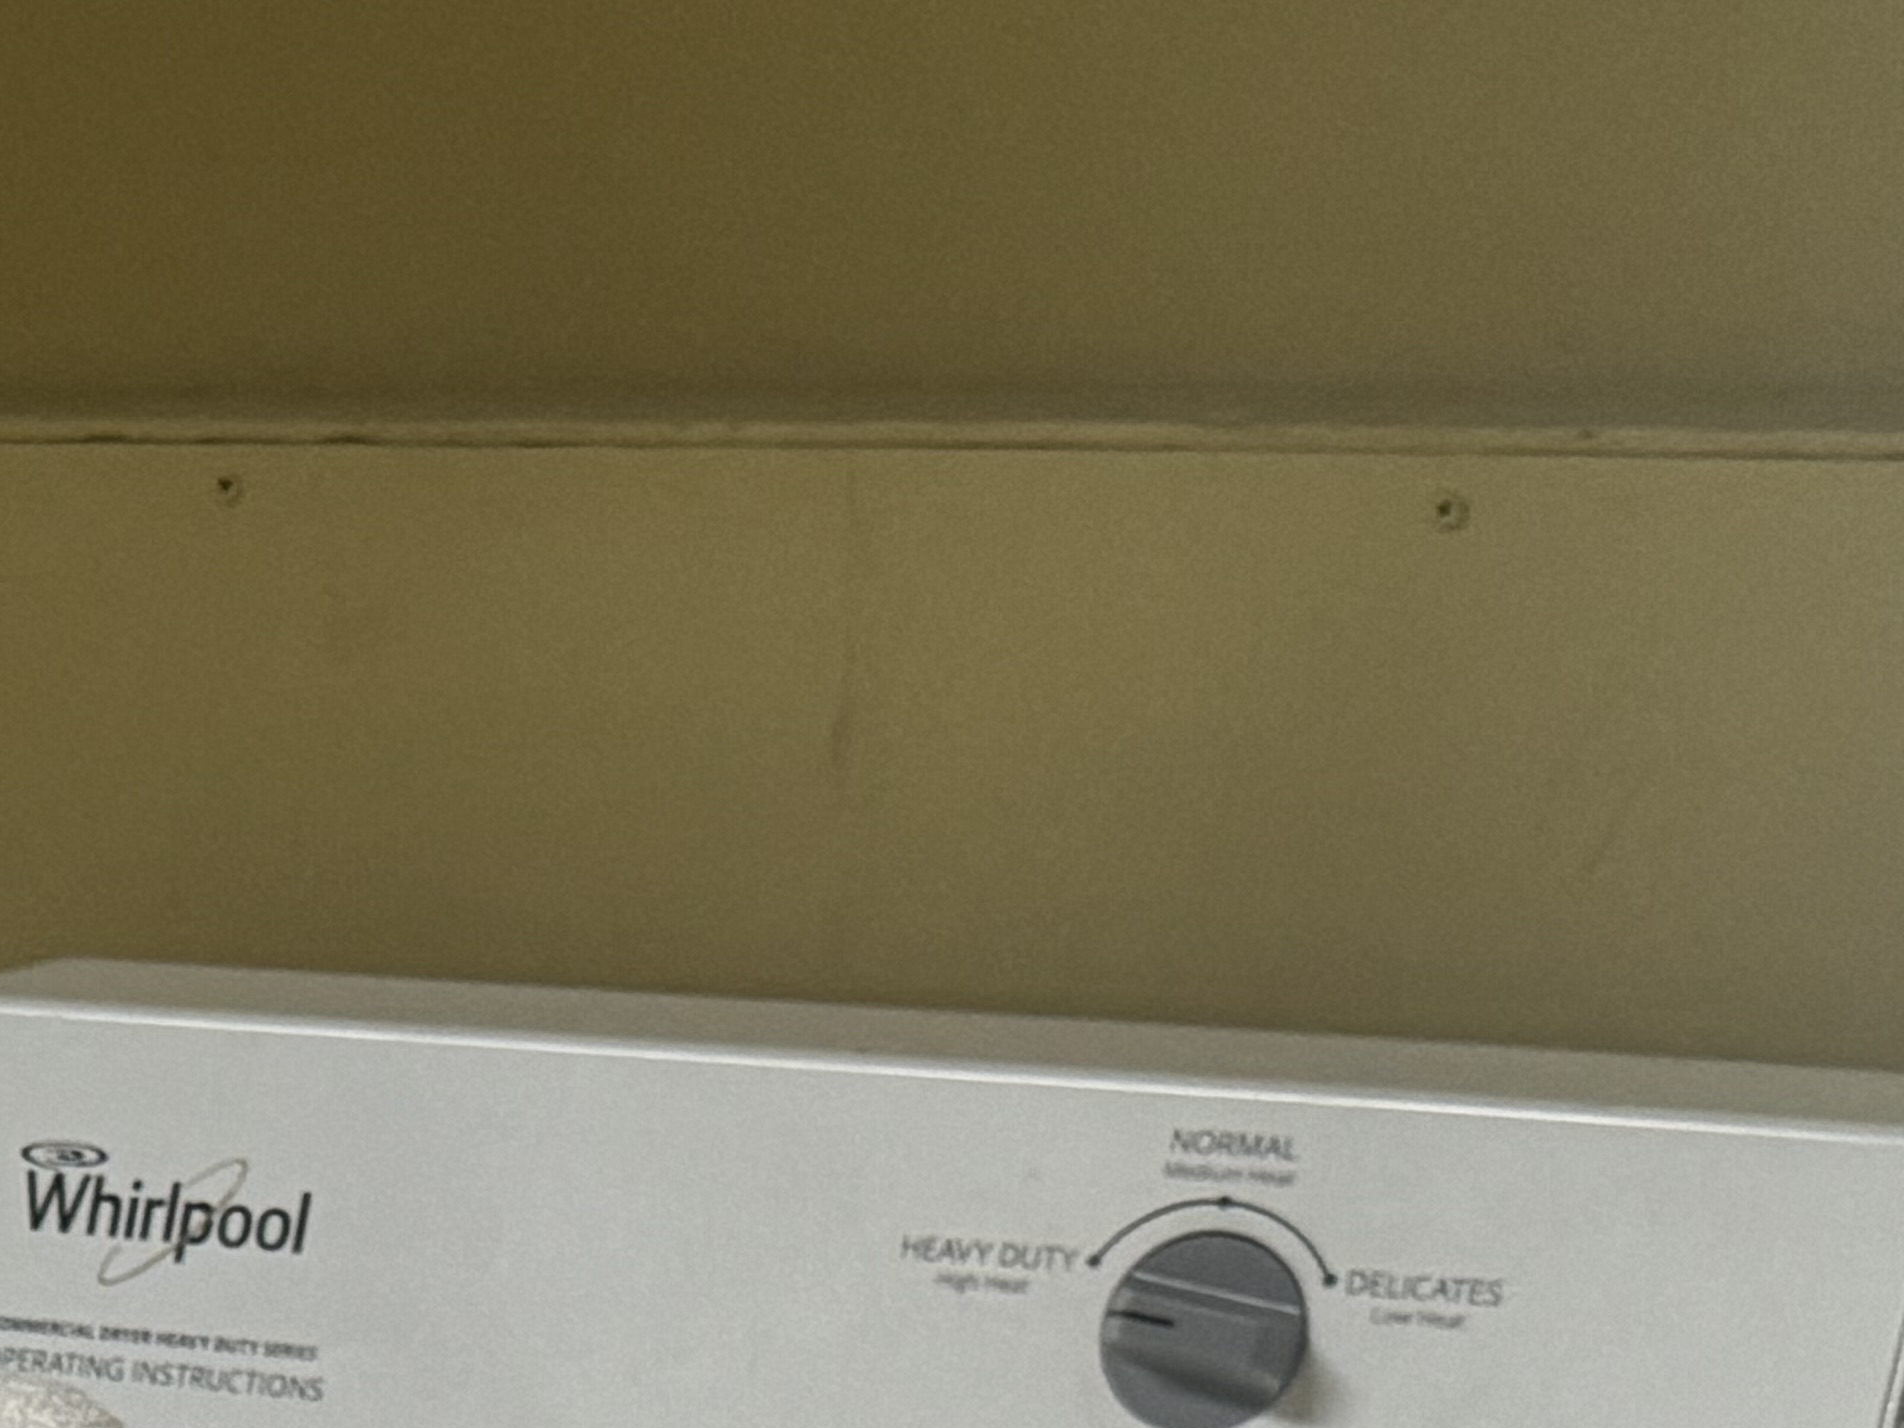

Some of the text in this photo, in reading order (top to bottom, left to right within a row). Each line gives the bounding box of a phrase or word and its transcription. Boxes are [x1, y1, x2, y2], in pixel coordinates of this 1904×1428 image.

[1169, 1128, 1299, 1163] NORMAL
[26, 1168, 312, 1264] Whirlpool
[900, 1235, 1079, 1272] HEAVY DUTY
[1344, 1269, 1505, 1307] DELICATES
[131, 1361, 325, 1402] INSTRUCTIONS
